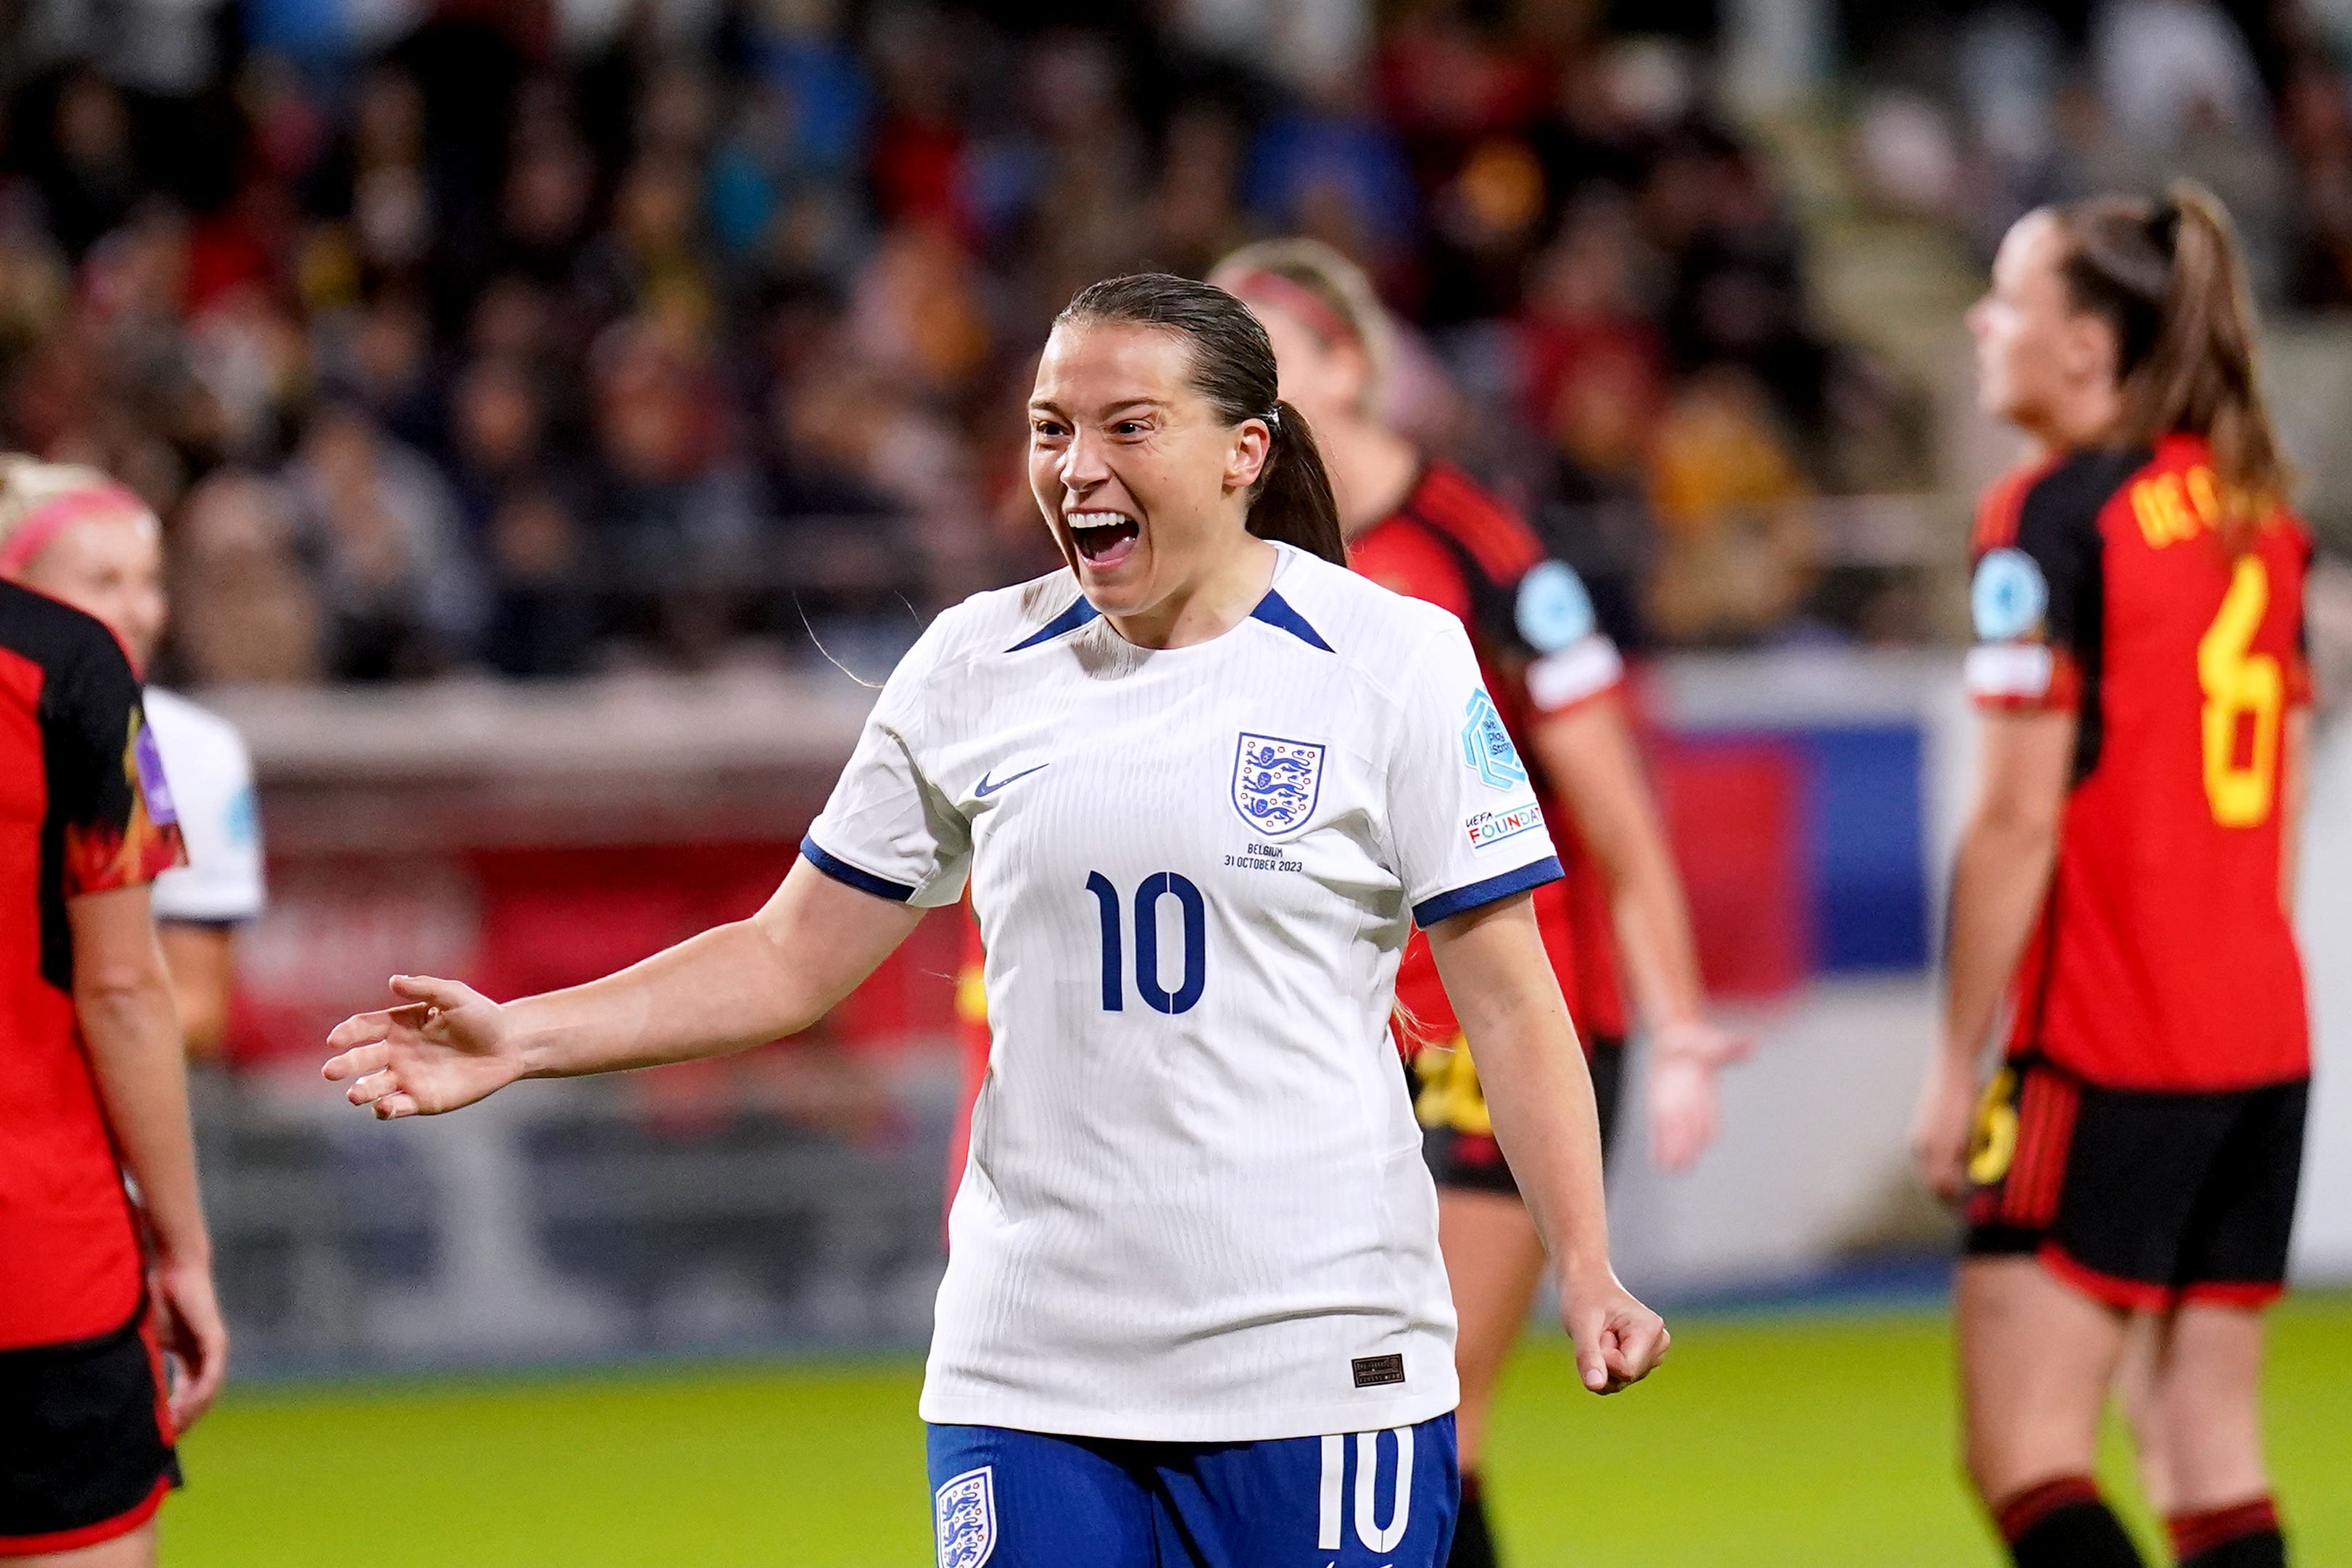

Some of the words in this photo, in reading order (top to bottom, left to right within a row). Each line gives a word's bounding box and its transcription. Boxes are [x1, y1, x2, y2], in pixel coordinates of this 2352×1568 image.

[2198, 553, 2284, 828] 6
[1248, 843, 1283, 858] BELGIUM
[1466, 811, 1493, 827] UEFA
[1225, 855, 1234, 866] 31
[1237, 856, 1275, 871] OCTOBER
[1279, 860, 1302, 872] 2023
[1085, 870, 1205, 1015] 10
[1318, 1426, 1414, 1554] 10
